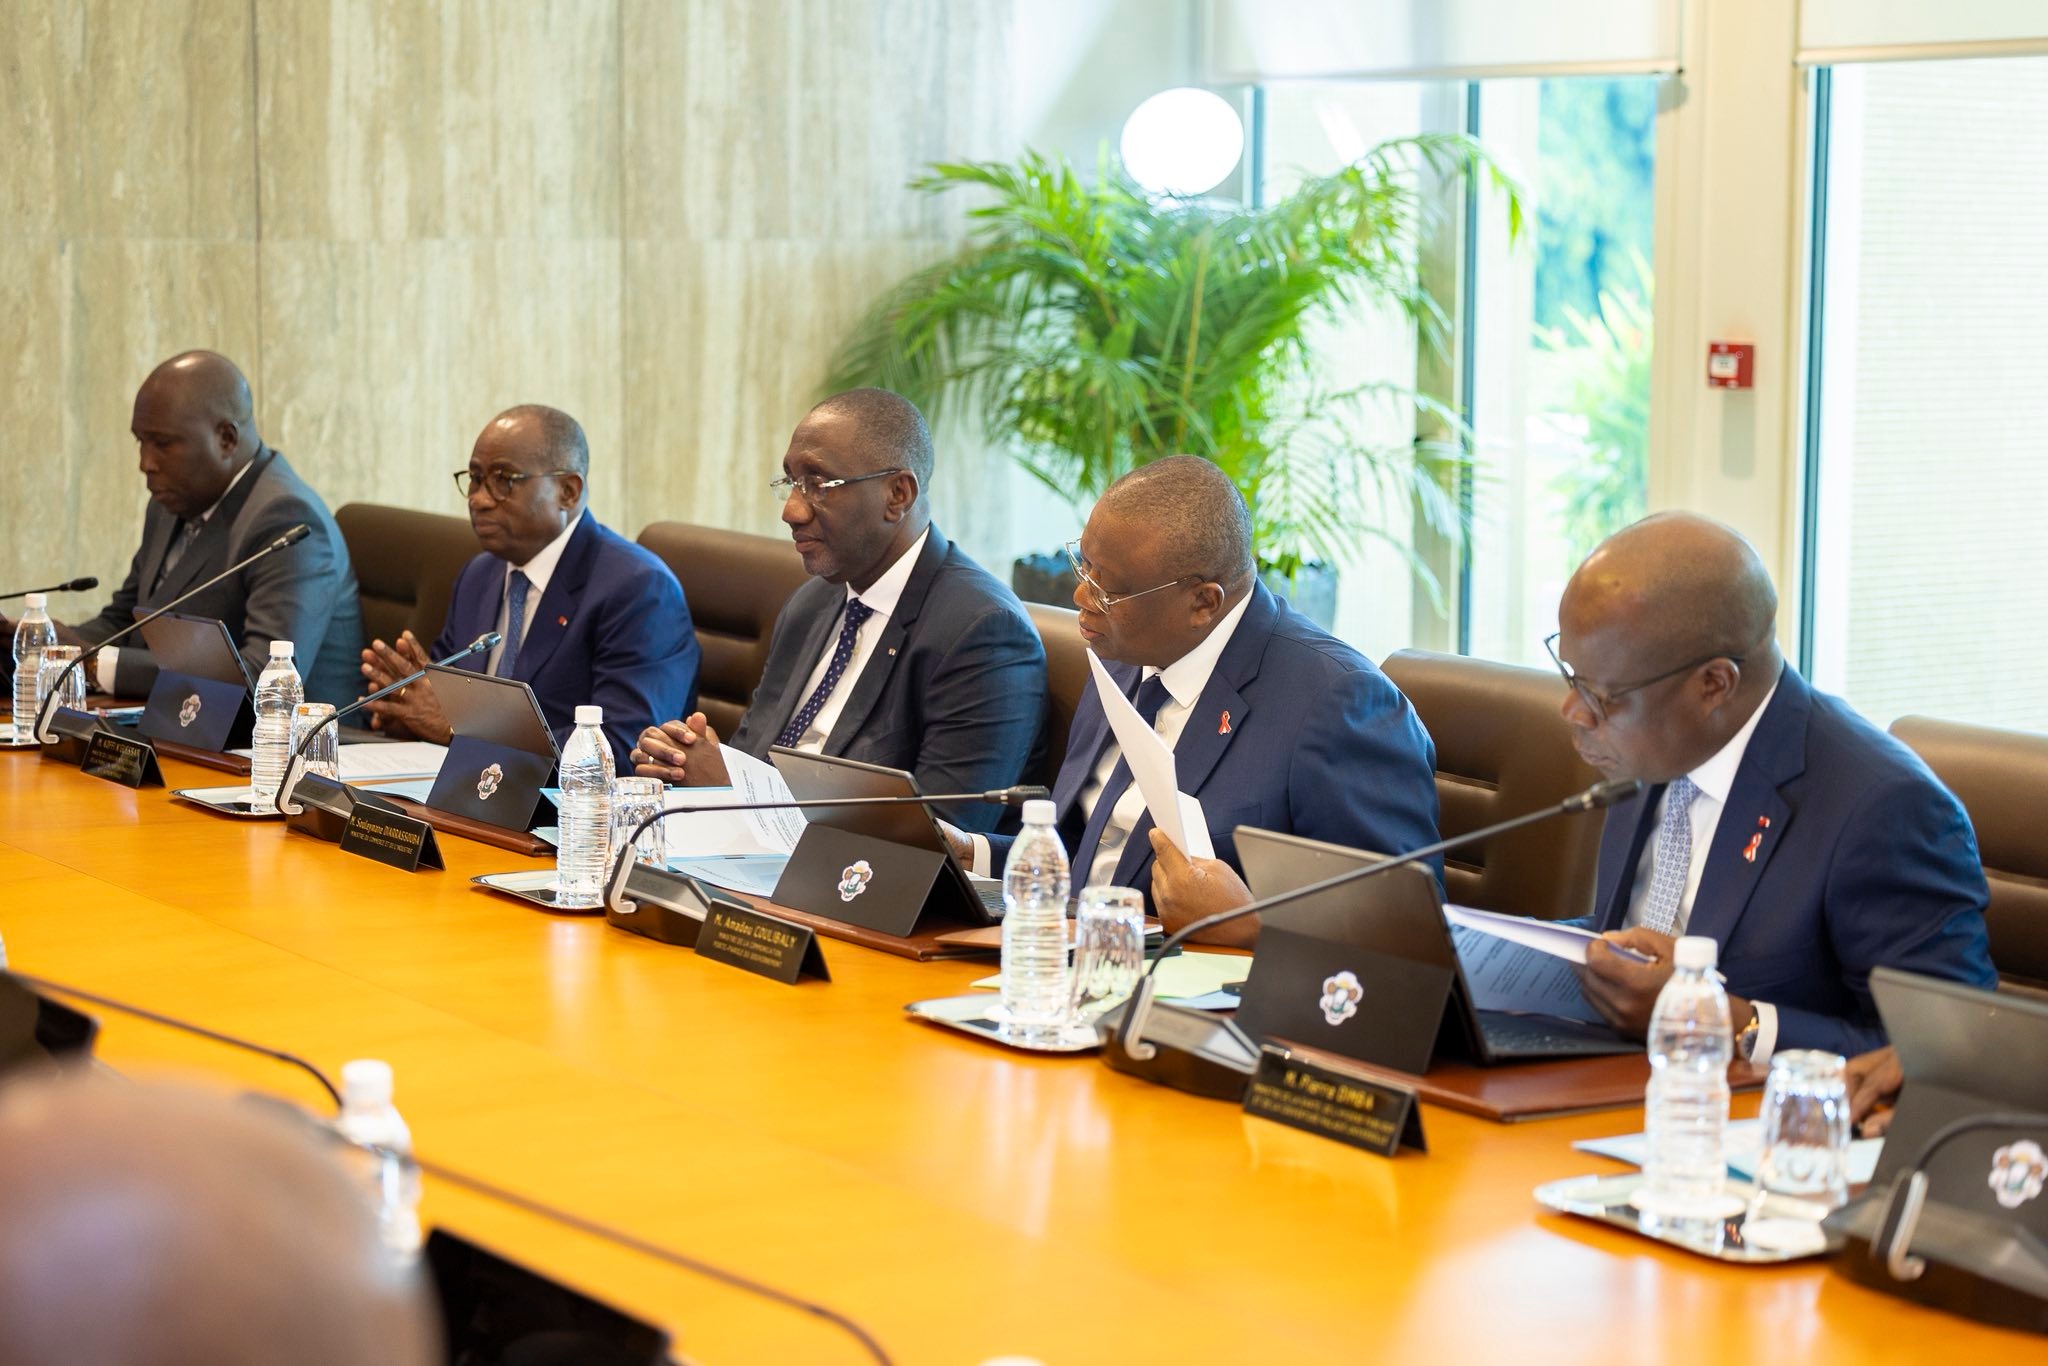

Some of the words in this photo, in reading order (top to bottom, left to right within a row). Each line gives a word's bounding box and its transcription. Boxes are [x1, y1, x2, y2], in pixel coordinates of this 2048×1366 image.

[383, 825, 420, 845] DIARRASSOUBA
[725, 916, 753, 935] Amadou
[753, 925, 797, 948] COULIBALY
